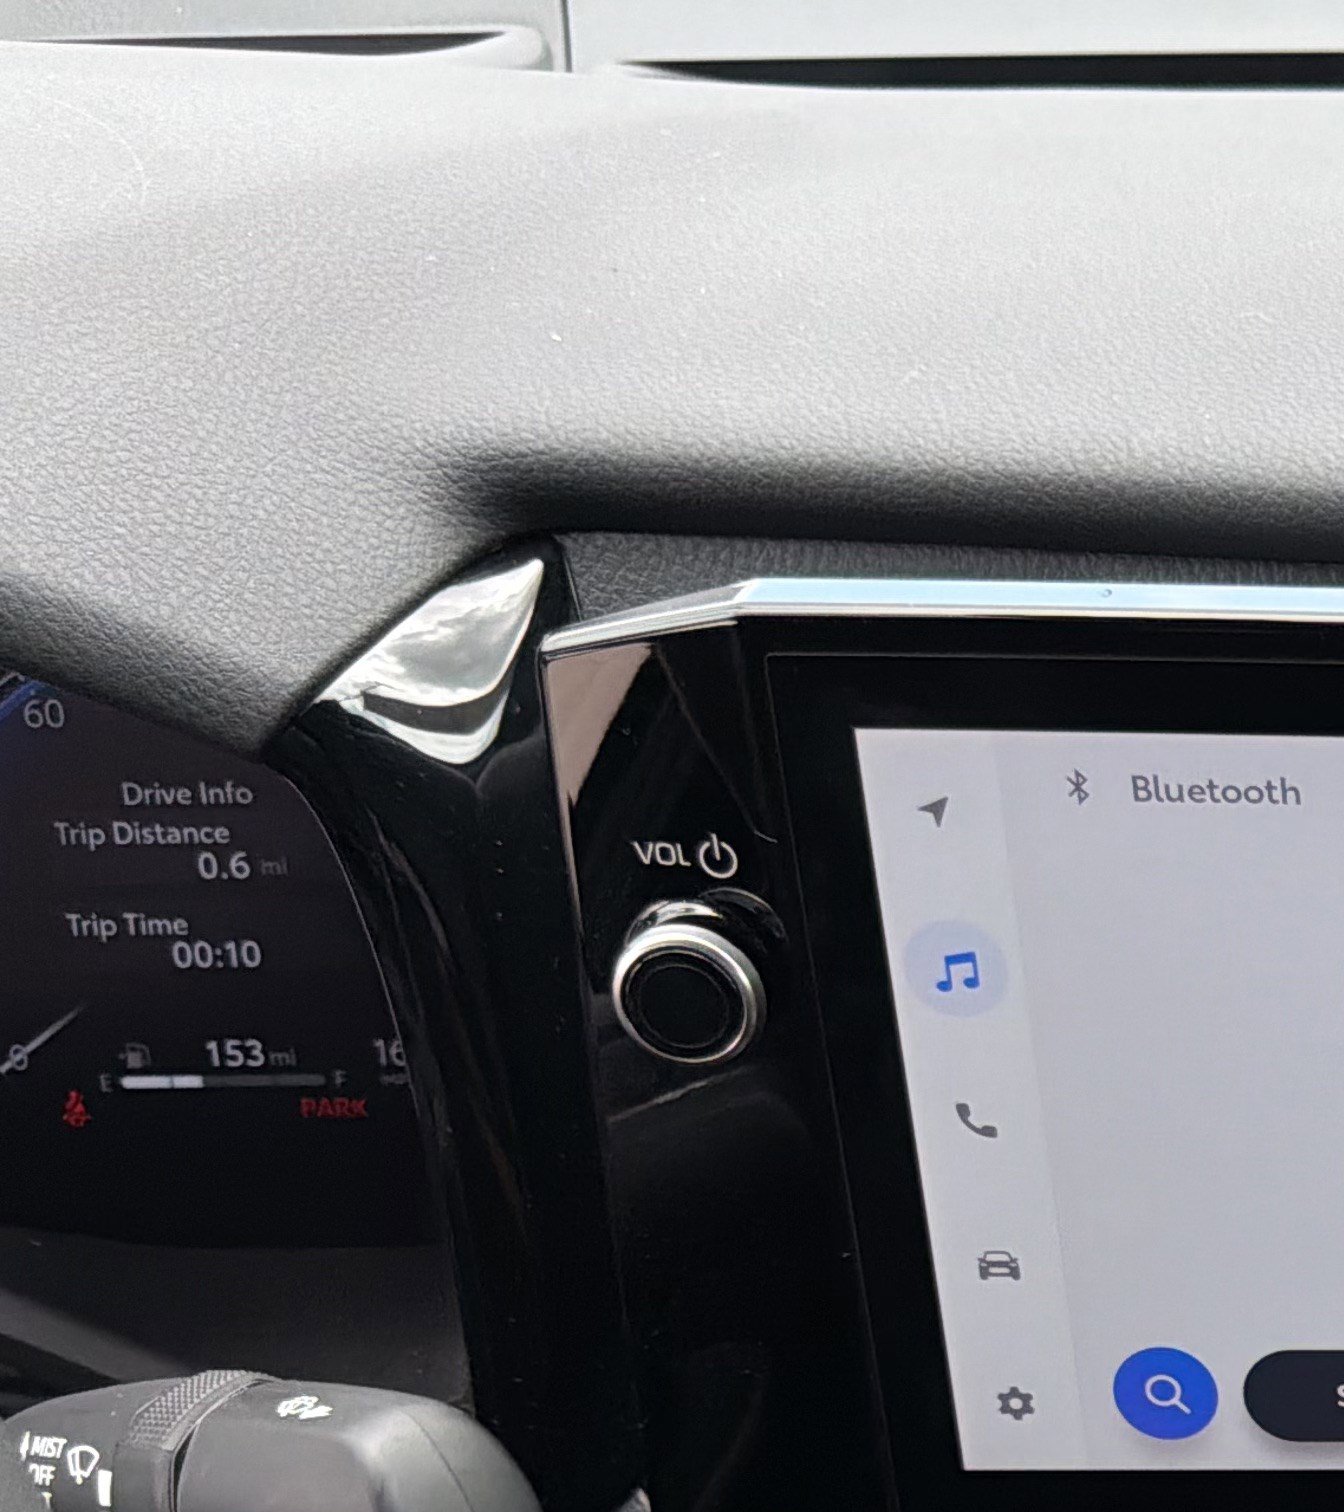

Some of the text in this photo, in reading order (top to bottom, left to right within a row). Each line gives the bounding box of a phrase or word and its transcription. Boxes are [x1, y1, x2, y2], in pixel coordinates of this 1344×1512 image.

[23, 699, 65, 729] 60
[121, 780, 254, 806] Drive Info
[1131, 774, 1302, 806] Bluetooth
[54, 820, 230, 851] Trip Distance
[198, 851, 289, 880] 0.6 mi
[632, 841, 692, 867] VOL
[65, 912, 189, 943] Trip Time
[171, 939, 262, 969] 00:10
[206, 1038, 297, 1068] 153 mi
[100, 1073, 113, 1093] E
[300, 1096, 368, 1118] PARK
[30, 1436, 67, 1459] MIST
